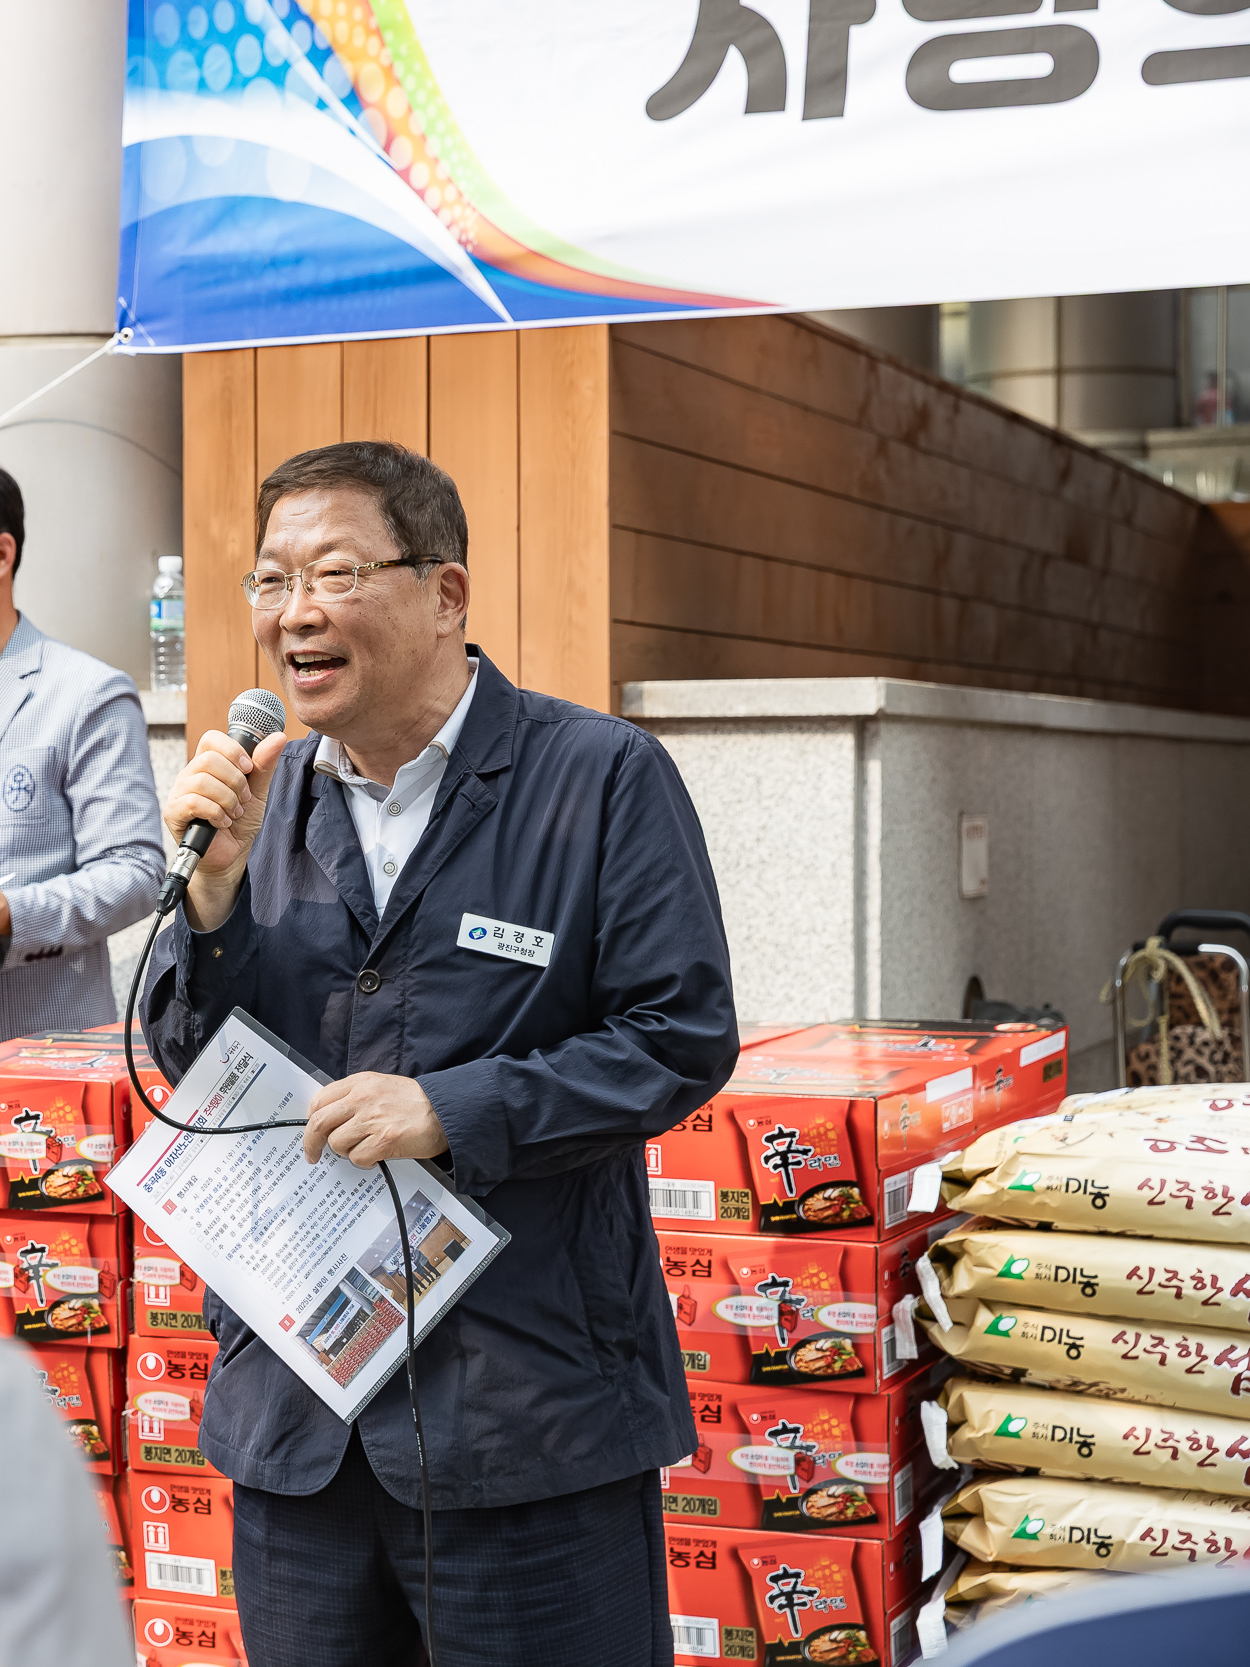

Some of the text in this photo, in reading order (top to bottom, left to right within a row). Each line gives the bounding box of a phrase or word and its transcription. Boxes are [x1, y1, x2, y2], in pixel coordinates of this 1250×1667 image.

[497, 942, 536, 958] 광진구청장
[142, 1165, 167, 1193] 중곡4동
[163, 1114, 207, 1168] 아차산노인지회
[202, 1091, 224, 1118] 추석맞이
[233, 1051, 254, 1074] 전달식
[761, 1124, 814, 1198] 辛
[807, 1154, 841, 1171] 라면
[175, 1174, 198, 1199] 행사개요
[1065, 1177, 1110, 1210] 미농
[720, 1190, 749, 1205] 봉지면
[720, 1206, 750, 1220] 20개입
[326, 1252, 349, 1277] 행사사진
[665, 1257, 712, 1278] 농심
[1054, 1265, 1099, 1298] 미농
[150, 1311, 178, 1328] 봉지면
[1040, 1326, 1084, 1360] 미농
[167, 1360, 208, 1380] 농심
[1051, 1425, 1096, 1458] 미농
[144, 1446, 205, 1466] 봉지면 20개입
[171, 1494, 212, 1515] 농심
[682, 1497, 718, 1516] 20개입
[1068, 1526, 1114, 1558] 미농
[669, 1548, 717, 1570] 농심
[765, 1564, 820, 1638] 辛
[813, 1596, 847, 1613] 라면
[175, 1627, 216, 1648] 농심
[724, 1628, 754, 1643] 봉지면
[724, 1644, 754, 1660] 20개입
